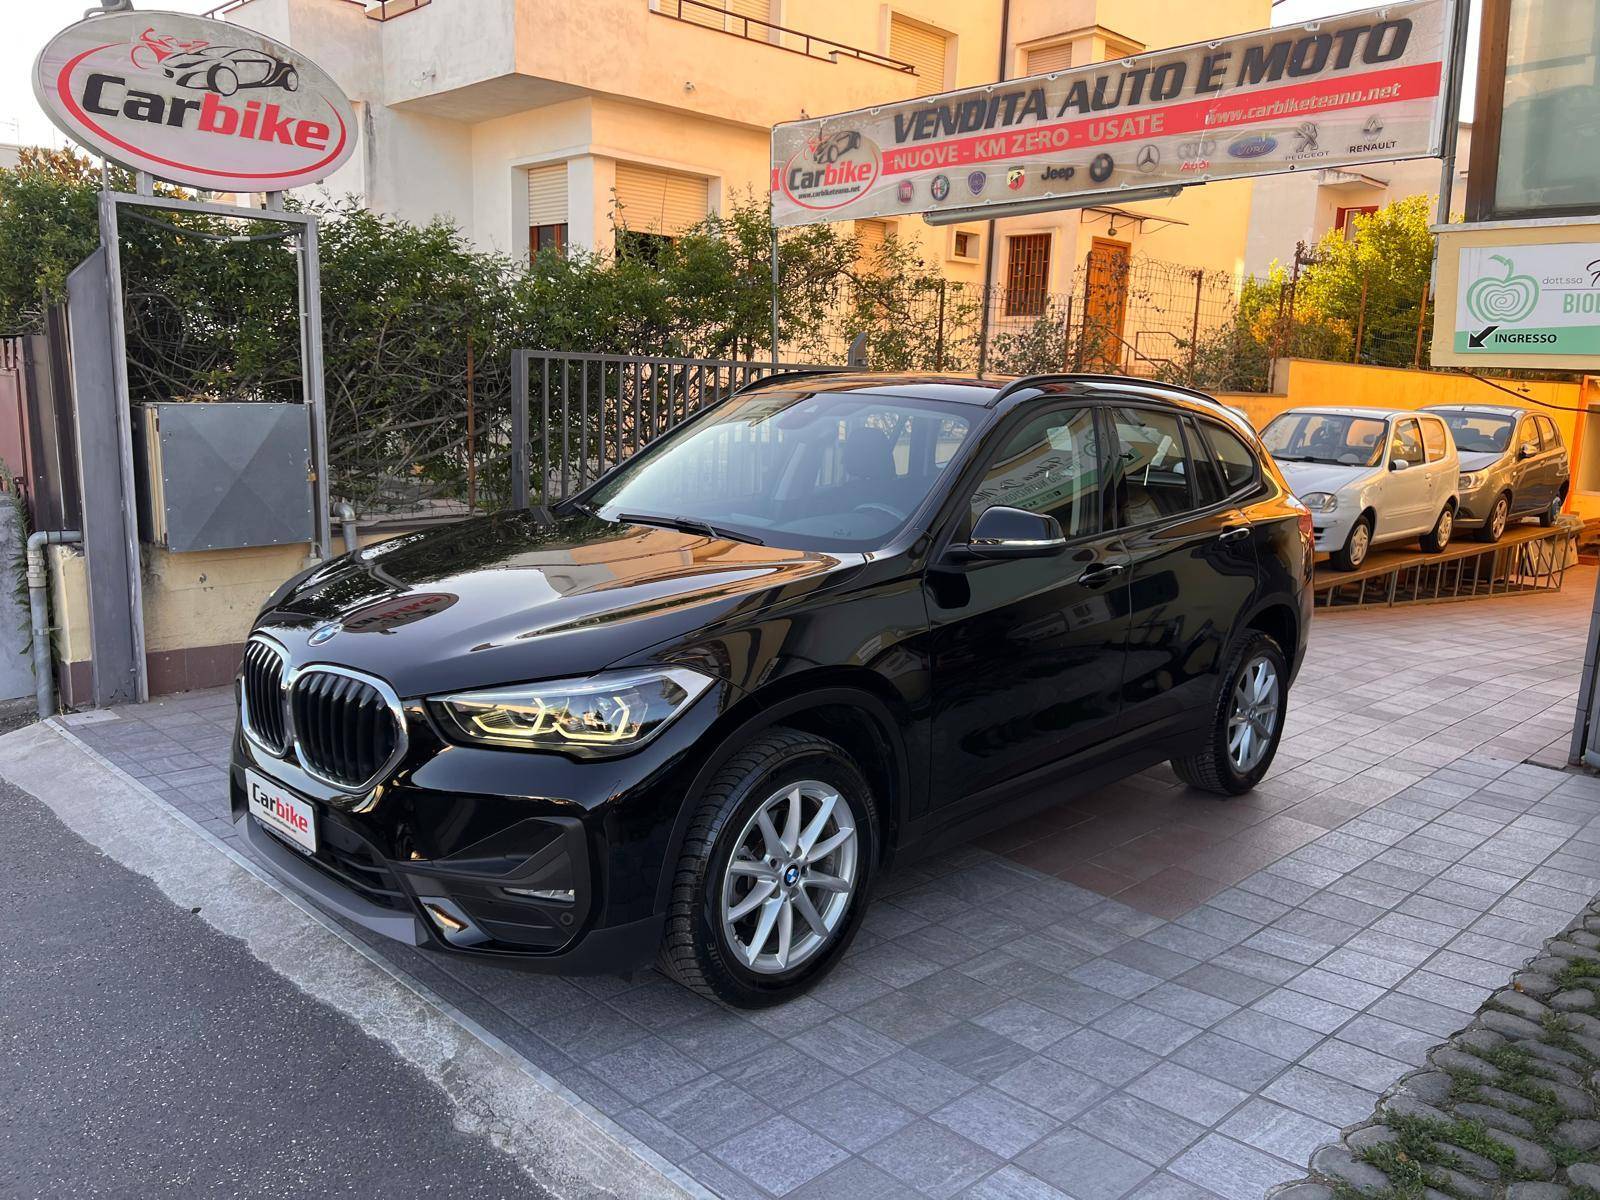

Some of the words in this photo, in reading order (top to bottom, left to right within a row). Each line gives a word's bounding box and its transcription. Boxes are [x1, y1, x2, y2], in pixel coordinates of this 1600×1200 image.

[894, 87, 1049, 144] VENDITA
[1056, 62, 1187, 118] AUTO
[1195, 51, 1232, 95] E
[1236, 18, 1413, 87] MOTO
[82, 73, 330, 151] Carbike
[1204, 83, 1402, 125] www.carbiketeano.net
[893, 145, 959, 170] NUOVE
[974, 137, 1007, 159] KM
[1011, 128, 1070, 153] ZERO
[1088, 113, 1165, 142] USATE
[1349, 141, 1397, 154] RENAULT
[1181, 160, 1209, 171] Audi
[1285, 150, 1330, 161] PEUGEOT
[788, 160, 873, 191] Carbike
[1041, 166, 1075, 180] Jeep
[1542, 276, 1583, 285] dott.ssa
[1494, 333, 1558, 344] INGRESSO
[253, 783, 308, 834] Carbike
